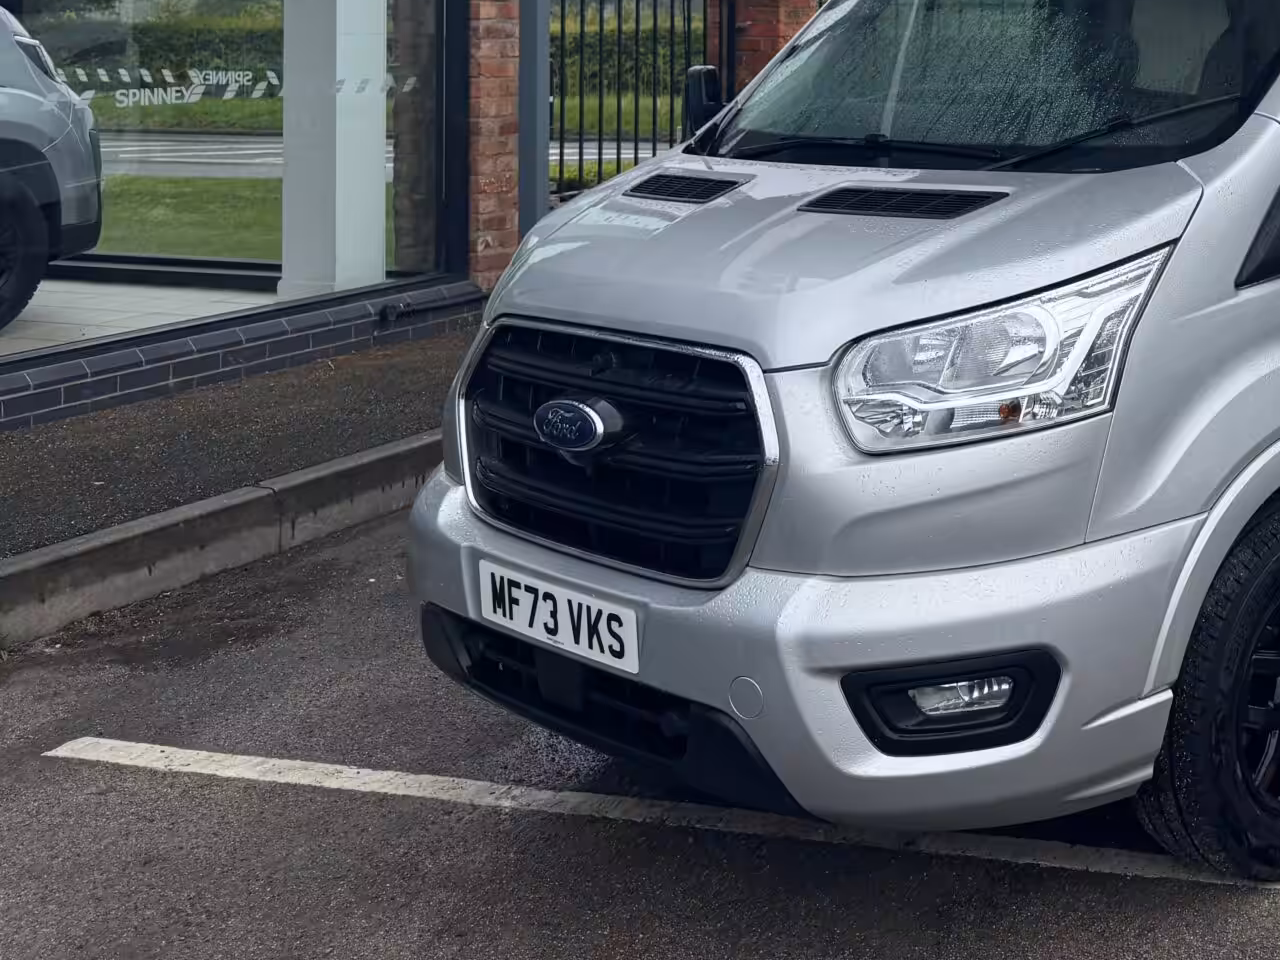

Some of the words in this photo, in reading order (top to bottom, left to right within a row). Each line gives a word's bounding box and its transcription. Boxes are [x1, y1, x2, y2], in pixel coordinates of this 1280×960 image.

[114, 86, 195, 108] SPINNEY
[543, 407, 582, 440] Ford
[490, 571, 559, 637] MF73
[567, 598, 625, 660] VKS
